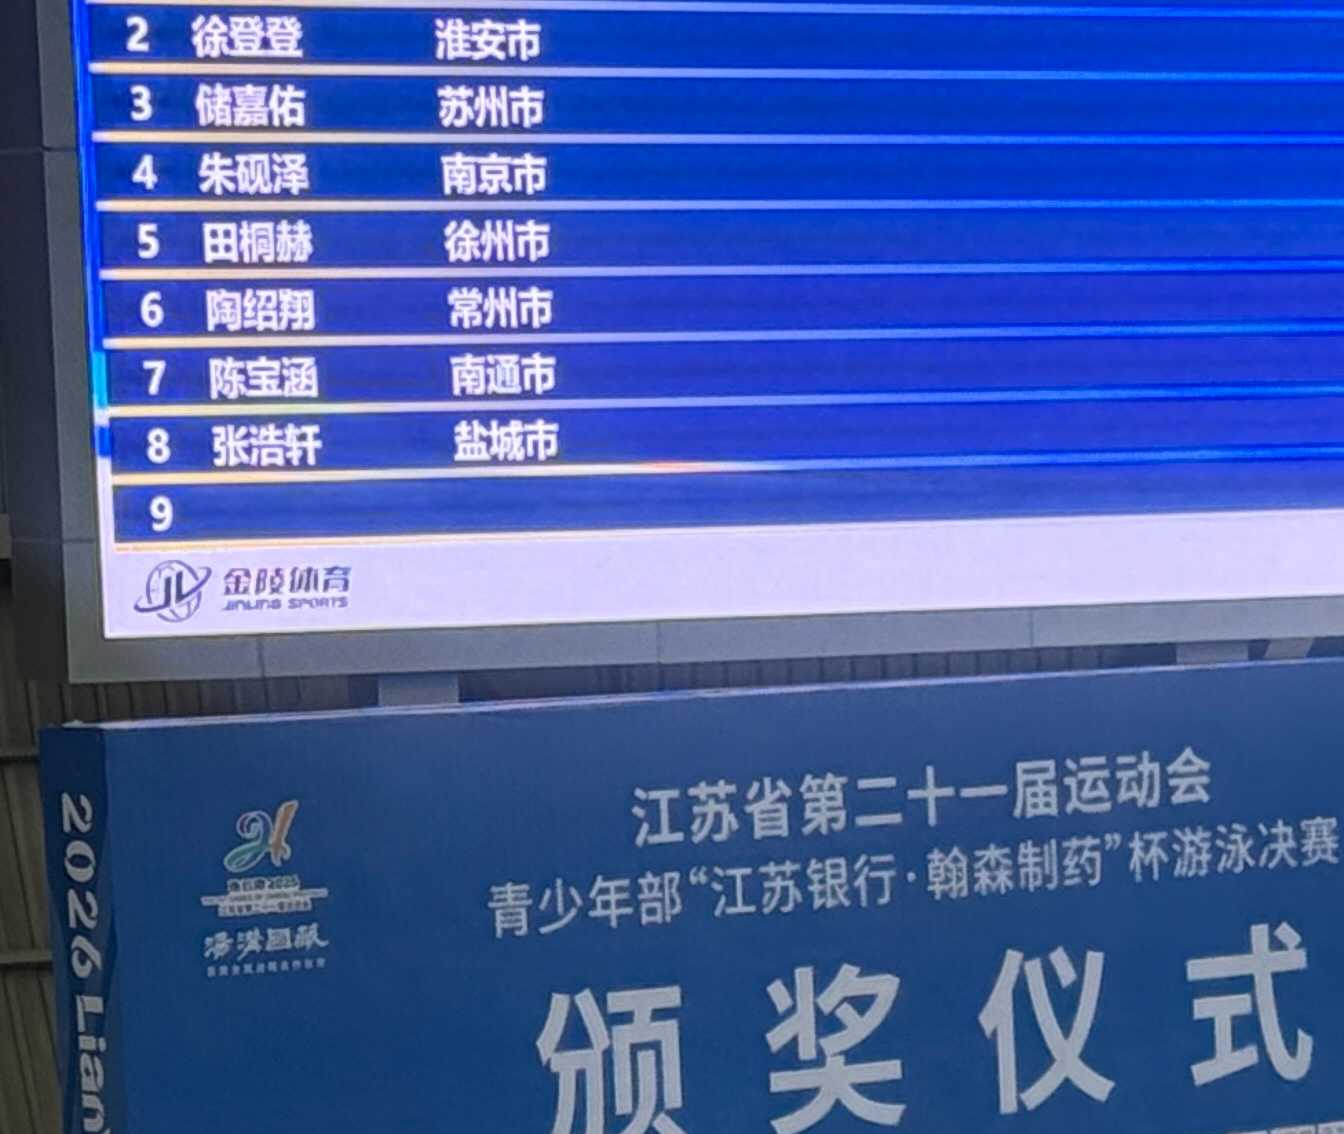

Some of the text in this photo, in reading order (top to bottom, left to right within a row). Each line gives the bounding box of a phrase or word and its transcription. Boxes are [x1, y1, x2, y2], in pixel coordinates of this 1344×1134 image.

[126, 14, 541, 60] 2 徐登登 淮安市
[130, 83, 545, 128] 3 储嘉佑 苏州市
[132, 153, 547, 195] 4 朱砚泽 南京市
[137, 220, 551, 263] 5 田桐赫 徐州市
[140, 287, 553, 331] 6 陶绍翔 常州市
[143, 353, 556, 398] 7 陈宝涵 南通市
[147, 420, 559, 466] 8 张浩轩 盐城市
[150, 496, 173, 532] 9
[223, 566, 351, 596] 金陵体育
[632, 747, 1212, 847] 江苏省第二十一届运动会
[61, 792, 102, 981] 2026
